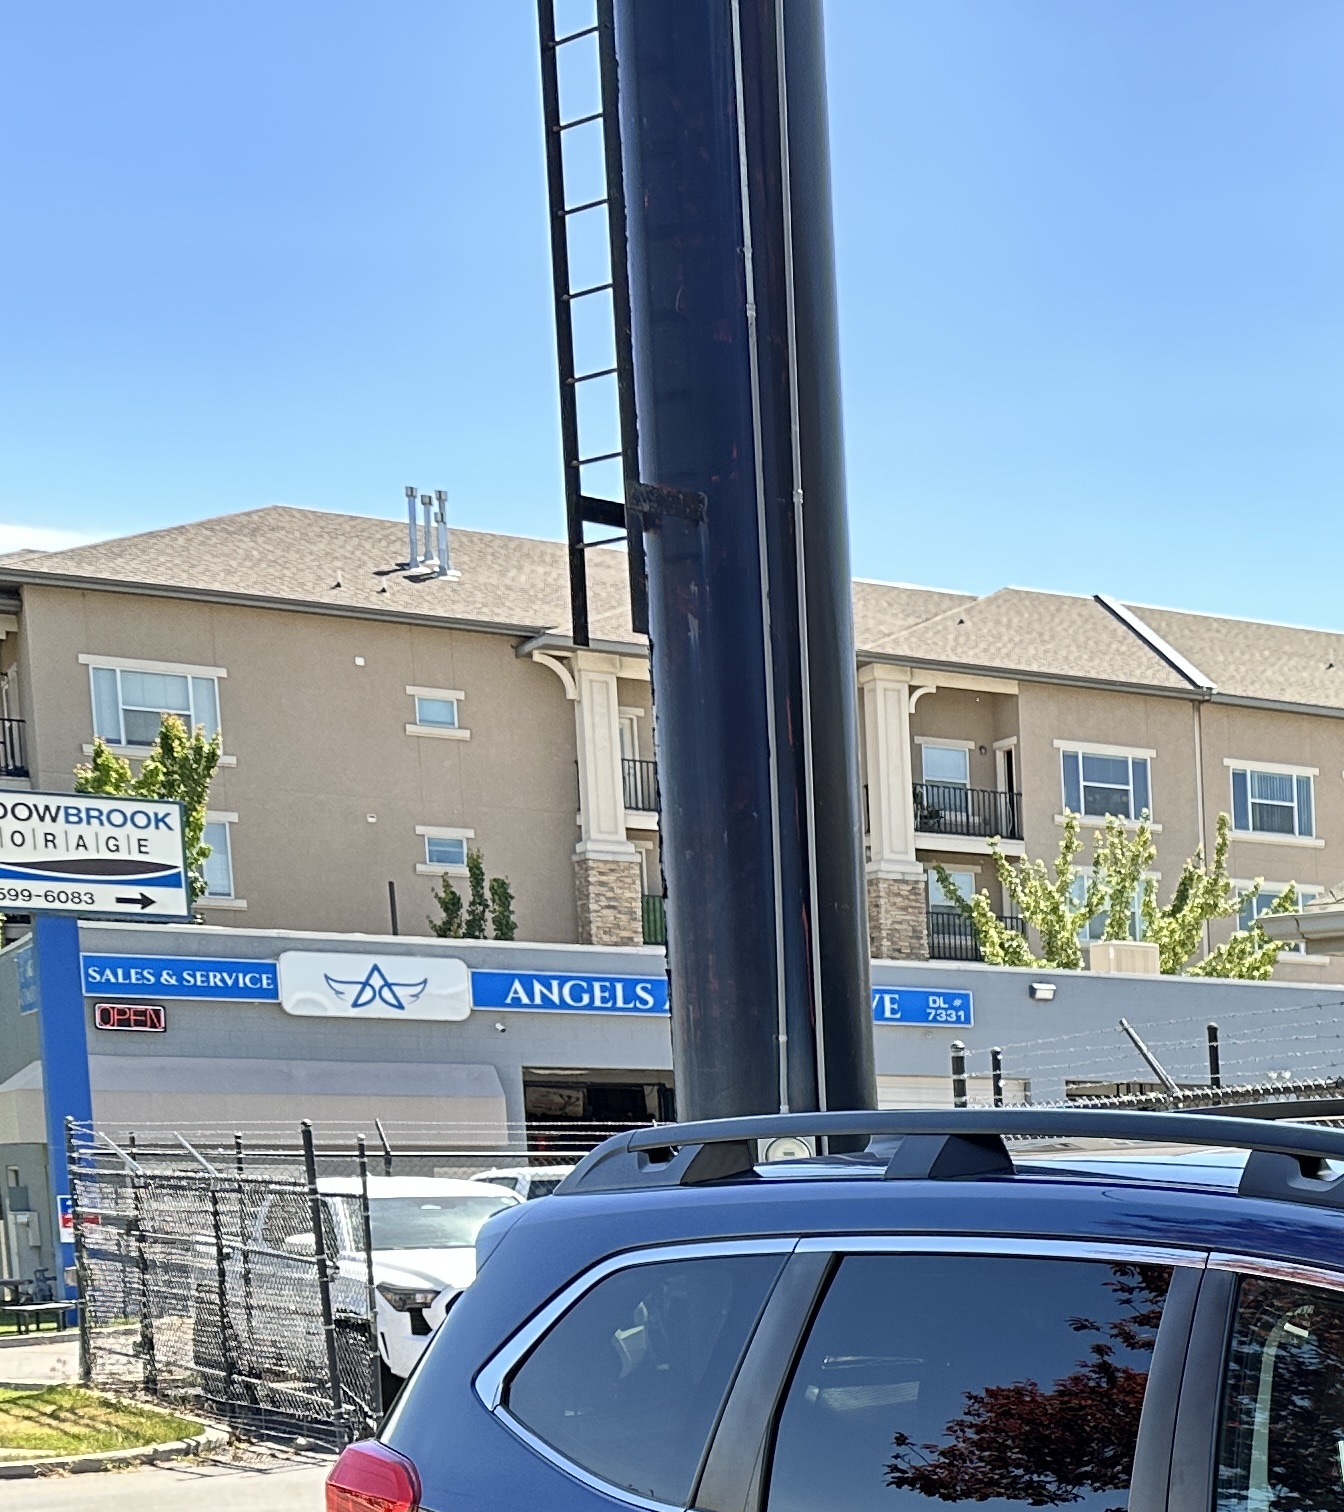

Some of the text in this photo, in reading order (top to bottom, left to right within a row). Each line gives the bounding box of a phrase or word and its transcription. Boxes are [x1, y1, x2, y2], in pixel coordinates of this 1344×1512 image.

[87, 966, 274, 989] SALES & SERVICE
[504, 978, 655, 1009] ANGELS
[928, 995, 949, 1008] DL
[98, 1006, 164, 1028] OPEN
[926, 1008, 965, 1022] 7331
